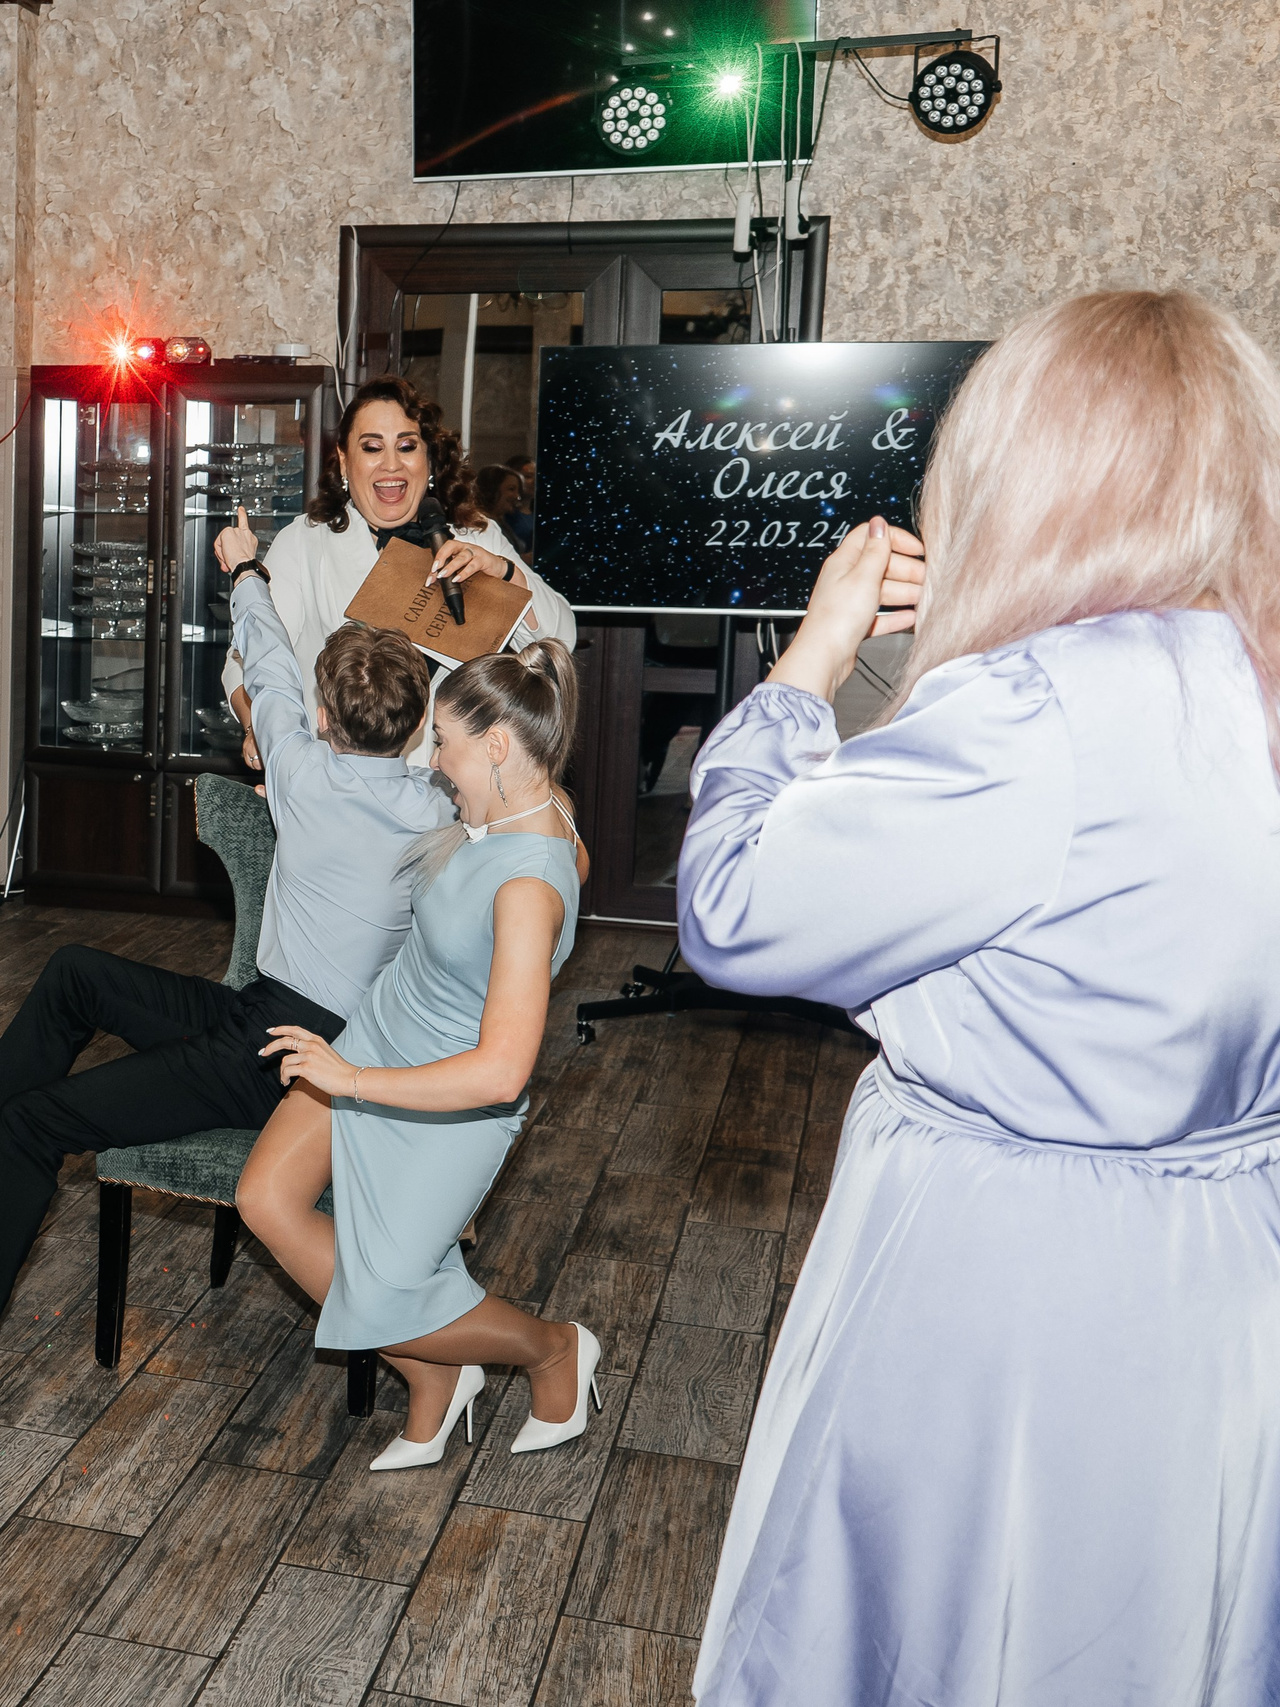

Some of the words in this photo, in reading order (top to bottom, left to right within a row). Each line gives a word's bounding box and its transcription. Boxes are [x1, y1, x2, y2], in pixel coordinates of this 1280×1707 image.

[652, 408, 849, 452] Алексей
[871, 407, 917, 451] &
[712, 457, 852, 500] Олеся
[704, 519, 851, 548] 22.03.24
